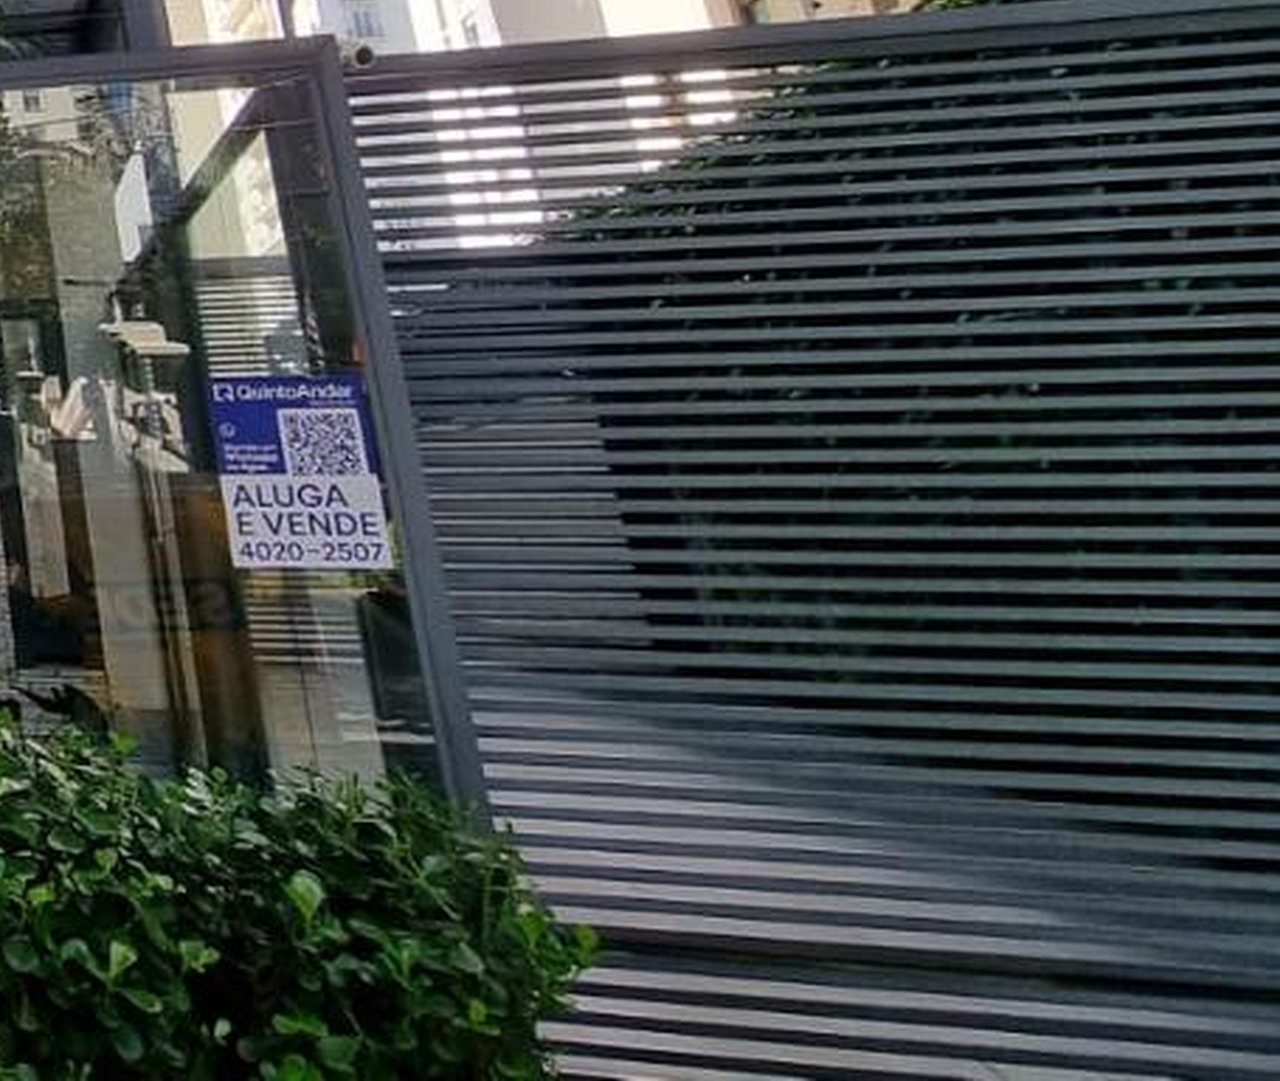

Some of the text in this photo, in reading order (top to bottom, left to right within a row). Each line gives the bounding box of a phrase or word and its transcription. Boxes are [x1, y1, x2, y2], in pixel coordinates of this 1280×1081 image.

[237, 384, 352, 400] QuintoAndar
[233, 484, 348, 508] ALUGA
[238, 512, 380, 536] E VENDE
[240, 542, 384, 562] 4020-2507
